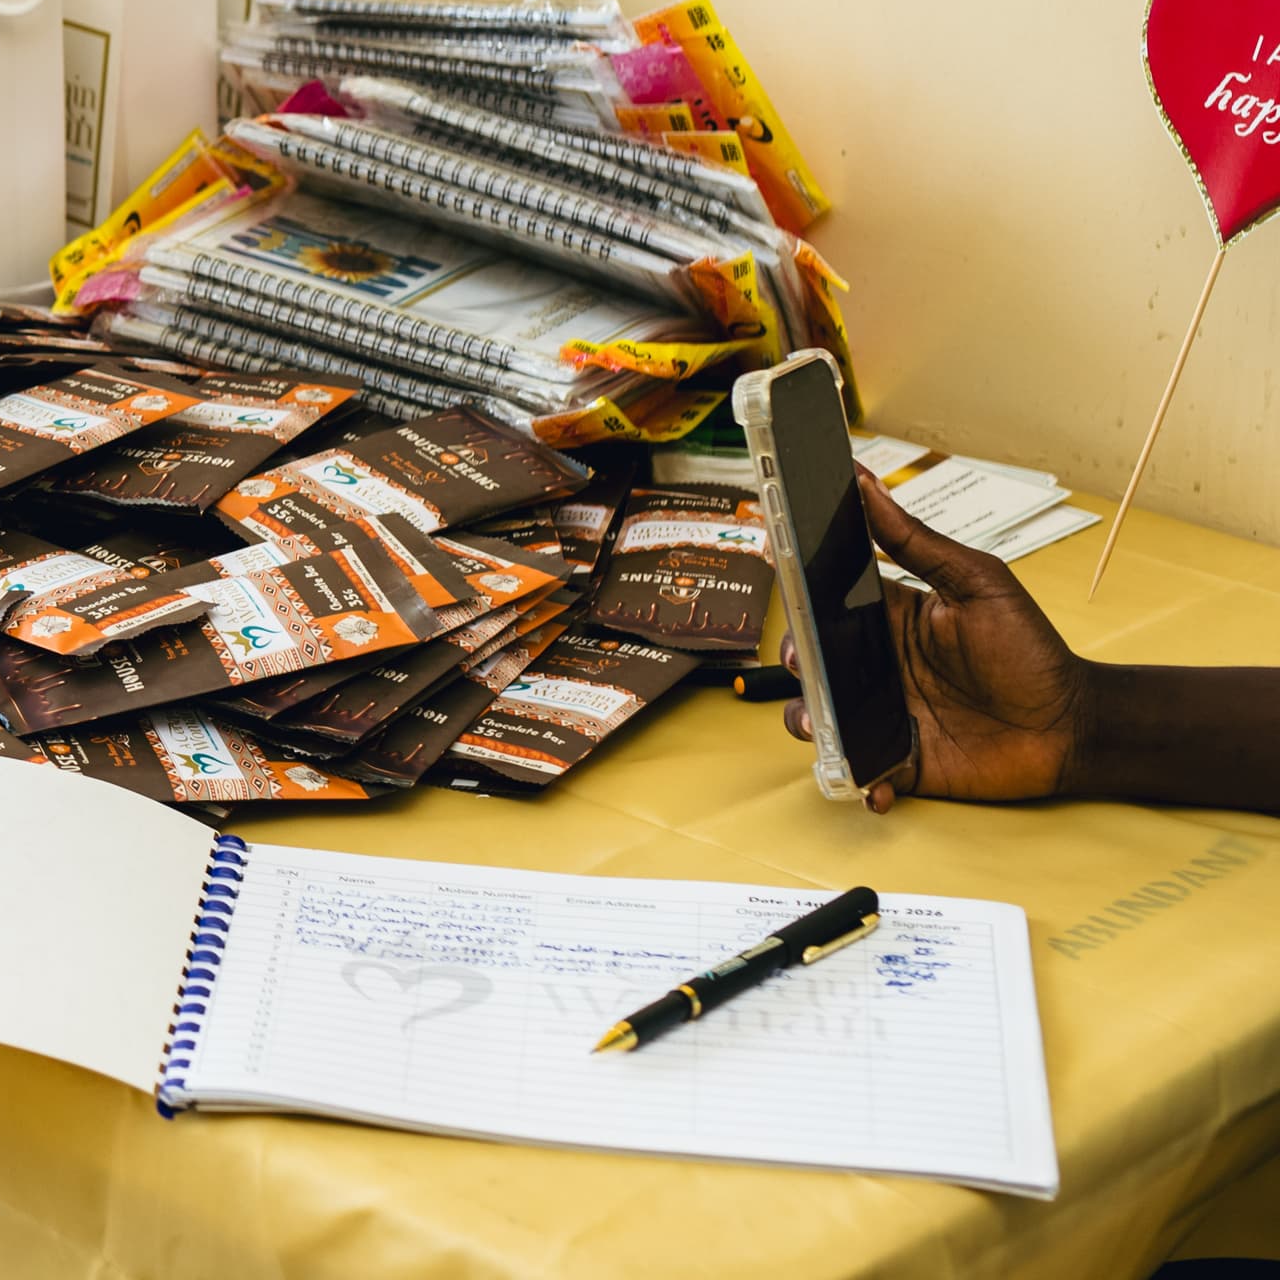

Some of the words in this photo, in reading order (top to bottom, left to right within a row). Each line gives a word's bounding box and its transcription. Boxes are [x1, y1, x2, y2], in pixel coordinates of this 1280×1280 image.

[1203, 71, 1280, 145] hap
[182, 453, 236, 468] HOUSE
[396, 427, 445, 456] HOUSE
[452, 462, 501, 491] BEANS
[281, 497, 328, 530] Chocolate
[85, 544, 135, 572] HOUSE
[303, 564, 320, 579] Bar
[618, 572, 674, 585] BEANS
[696, 577, 753, 595] HOUSE
[74, 590, 128, 614] Chocolate
[125, 584, 149, 597] Bar
[312, 576, 344, 611] Chocolate
[558, 635, 600, 647] OUSE
[617, 641, 673, 664] BEANS
[109, 655, 145, 693] HOUSE
[481, 718, 540, 736] Chocolate
[542, 730, 566, 746] Bar
[54, 754, 81, 773] USE
[466, 746, 486, 757] Made
[338, 874, 376, 886] Name
[438, 884, 480, 897] Mobile
[481, 889, 533, 901] Number
[565, 896, 603, 906] Email
[604, 900, 657, 910] Address
[891, 919, 962, 933] Signature
[748, 895, 789, 907] Date:
[905, 907, 944, 918] 2026
